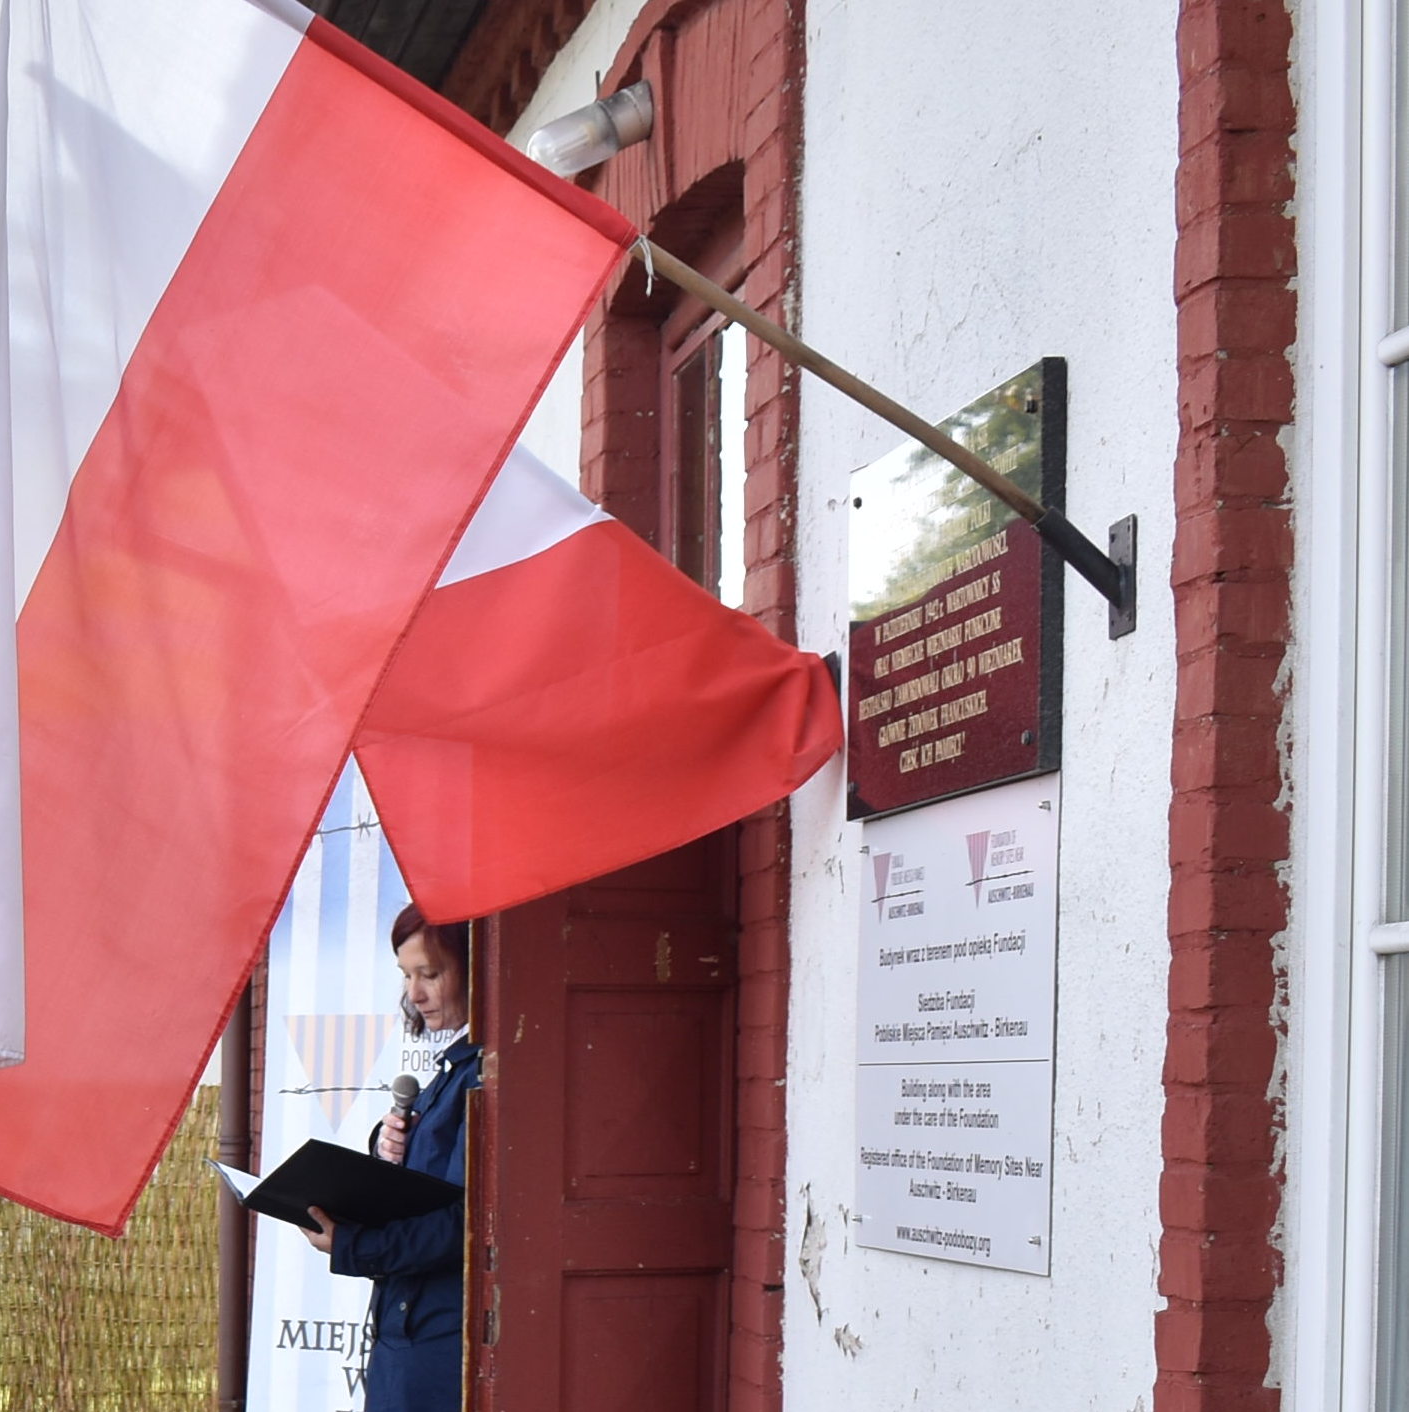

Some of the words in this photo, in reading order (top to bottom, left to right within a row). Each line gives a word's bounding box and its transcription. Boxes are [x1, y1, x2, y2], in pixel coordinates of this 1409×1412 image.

[991, 570, 1001, 595] SS
[966, 656, 976, 681] 90
[879, 946, 905, 970] Budynek
[906, 947, 920, 963] wraz
[926, 942, 953, 961] terenem
[953, 937, 967, 962] pod
[968, 934, 992, 960] opieką
[993, 929, 1026, 955] Fundacji
[918, 992, 945, 1012] Siedziba
[946, 988, 976, 1014] Fundacji
[874, 1022, 902, 1043] Pobliskie
[902, 1021, 926, 1046] Miejsca
[926, 1019, 953, 1045] Pamięci
[953, 1018, 989, 1039] Auschwitz
[994, 1016, 1028, 1038] Birkenau
[901, 1078, 927, 1102] Building
[927, 1078, 946, 1103] along
[947, 1078, 962, 1098] with
[963, 1079, 974, 1097] the
[975, 1082, 991, 1098] area
[894, 1107, 912, 1126] under
[912, 1107, 923, 1126] the
[923, 1111, 938, 1127] care
[947, 1108, 958, 1127] the
[959, 1107, 999, 1128] Foundation
[860, 1146, 890, 1170] Registered
[891, 1148, 907, 1168] office
[916, 1149, 926, 1169] the
[927, 1150, 964, 1172] Foundation
[965, 1153, 974, 1173] of
[974, 1153, 1003, 1180] Memory
[1004, 1154, 1024, 1176] Sites
[1025, 1156, 1044, 1178] Near
[908, 1178, 941, 1199] Auschwitz
[946, 1180, 977, 1203] Birkenau
[896, 1225, 991, 1257] www.auschwitz-podobozy.org
